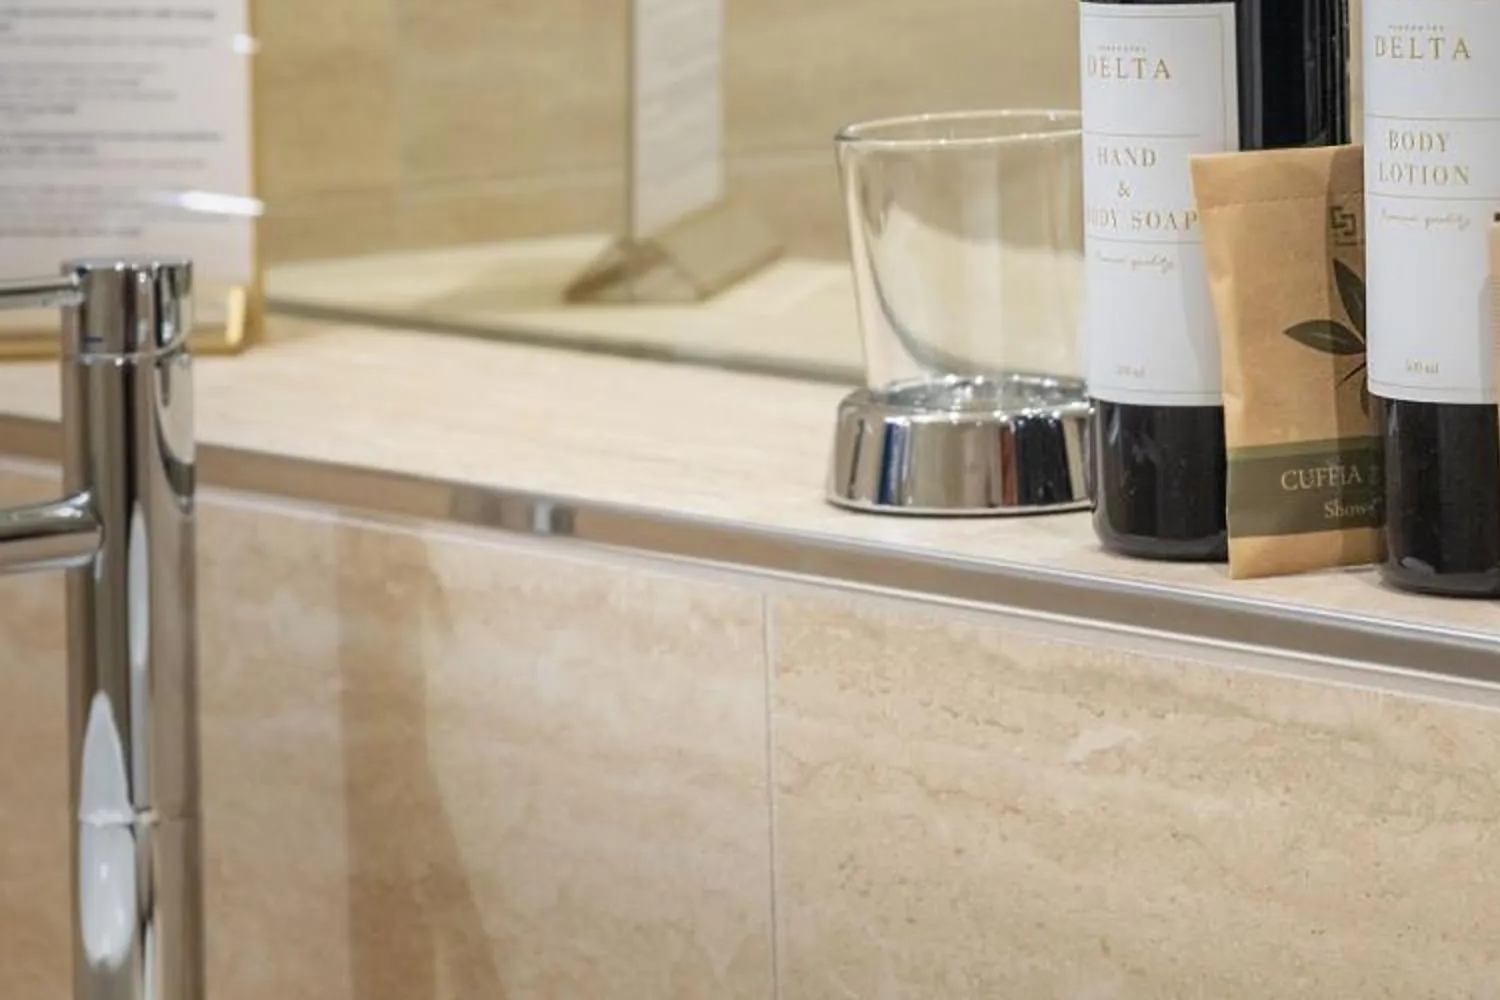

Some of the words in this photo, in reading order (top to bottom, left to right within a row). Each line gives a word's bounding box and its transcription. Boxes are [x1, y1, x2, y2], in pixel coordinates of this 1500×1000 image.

[1374, 34, 1472, 61] DELTA
[1086, 55, 1171, 81] DELTA
[1388, 129, 1449, 153] BODY
[1097, 145, 1156, 168] HAND
[1378, 161, 1470, 187] LOTION
[1118, 180, 1131, 199] &
[1087, 206, 1118, 229] ODY
[1131, 208, 1198, 232] SOAP
[1281, 463, 1362, 491] CUFFIA
[1324, 498, 1369, 519] Show
